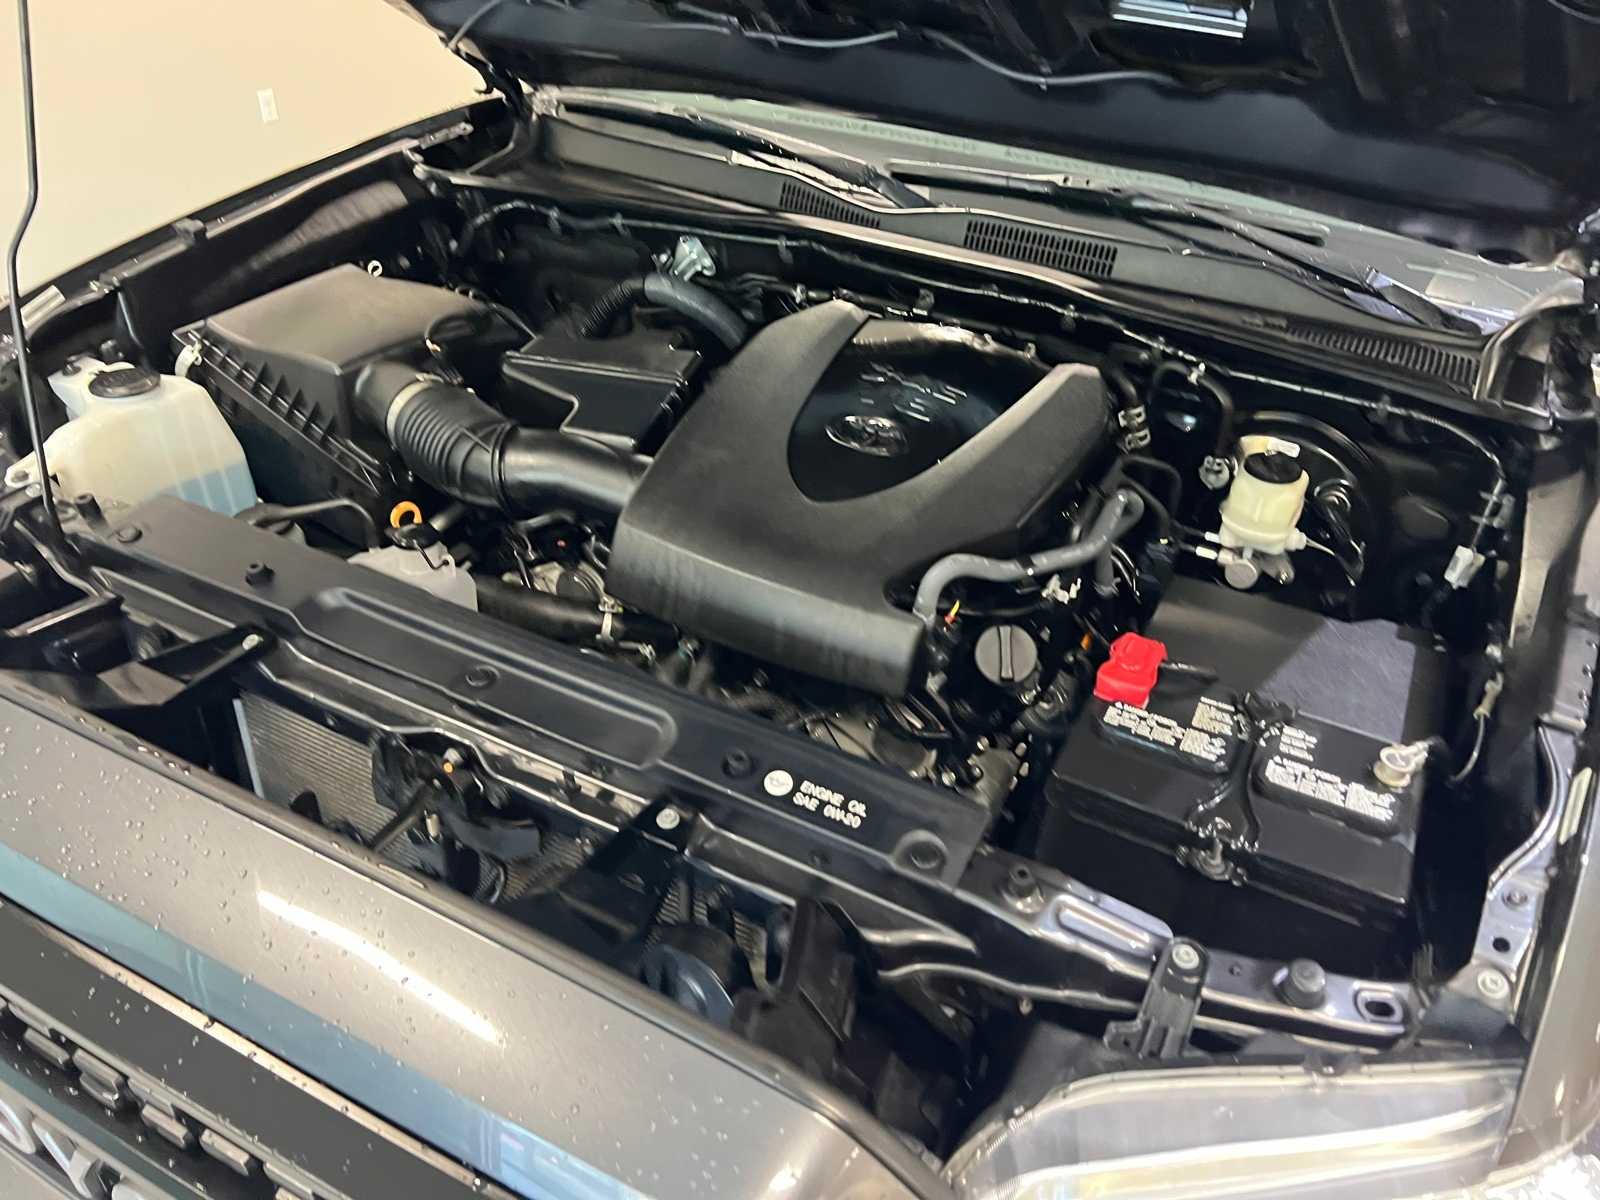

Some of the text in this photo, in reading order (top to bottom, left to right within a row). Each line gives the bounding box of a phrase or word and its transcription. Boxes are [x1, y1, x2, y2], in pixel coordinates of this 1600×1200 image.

[793, 792, 819, 812] SAE
[800, 780, 867, 818] ENGINE OIL
